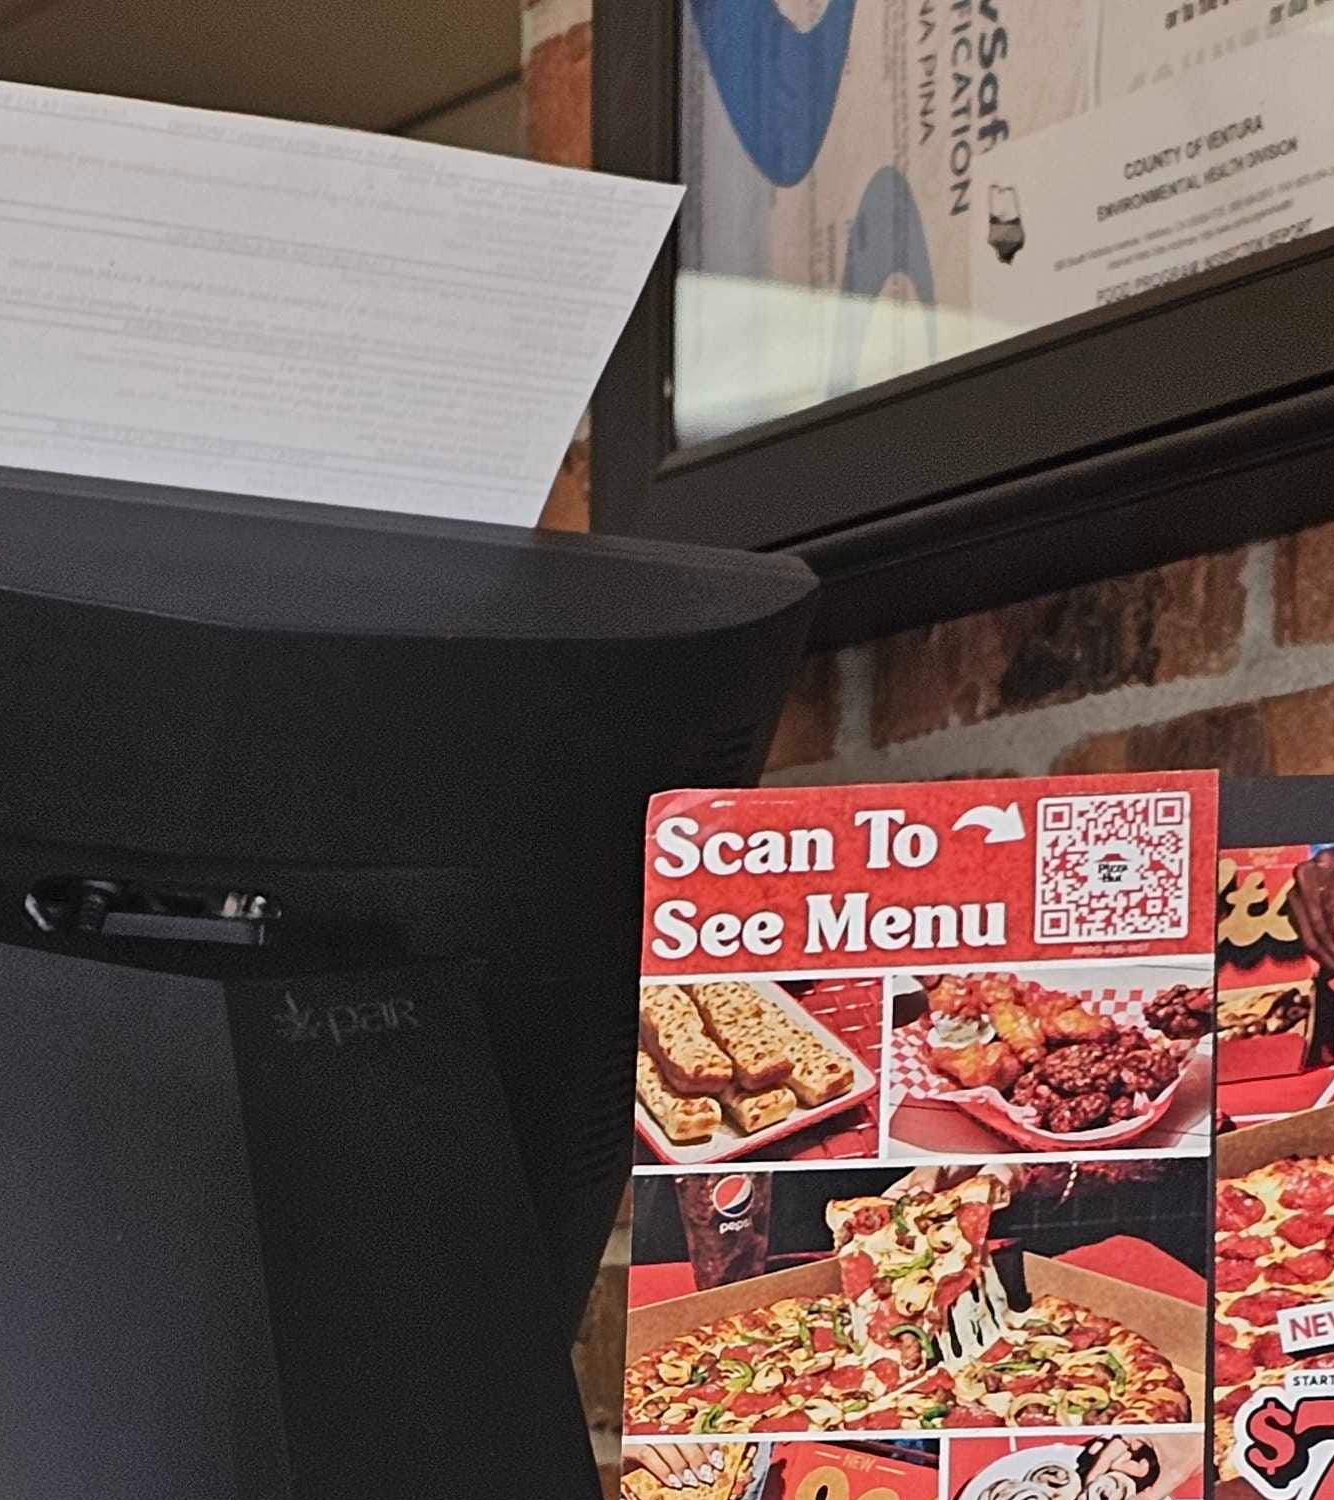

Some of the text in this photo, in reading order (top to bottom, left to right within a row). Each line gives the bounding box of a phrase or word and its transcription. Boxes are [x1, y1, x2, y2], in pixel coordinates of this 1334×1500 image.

[1123, 114, 1264, 180] COUNTY OF VENTURA
[1097, 174, 1200, 222] ENVIRONMENTAL
[652, 808, 940, 879] Scan To
[650, 891, 1008, 961] See Menu
[843, 1454, 876, 1473] NEW
